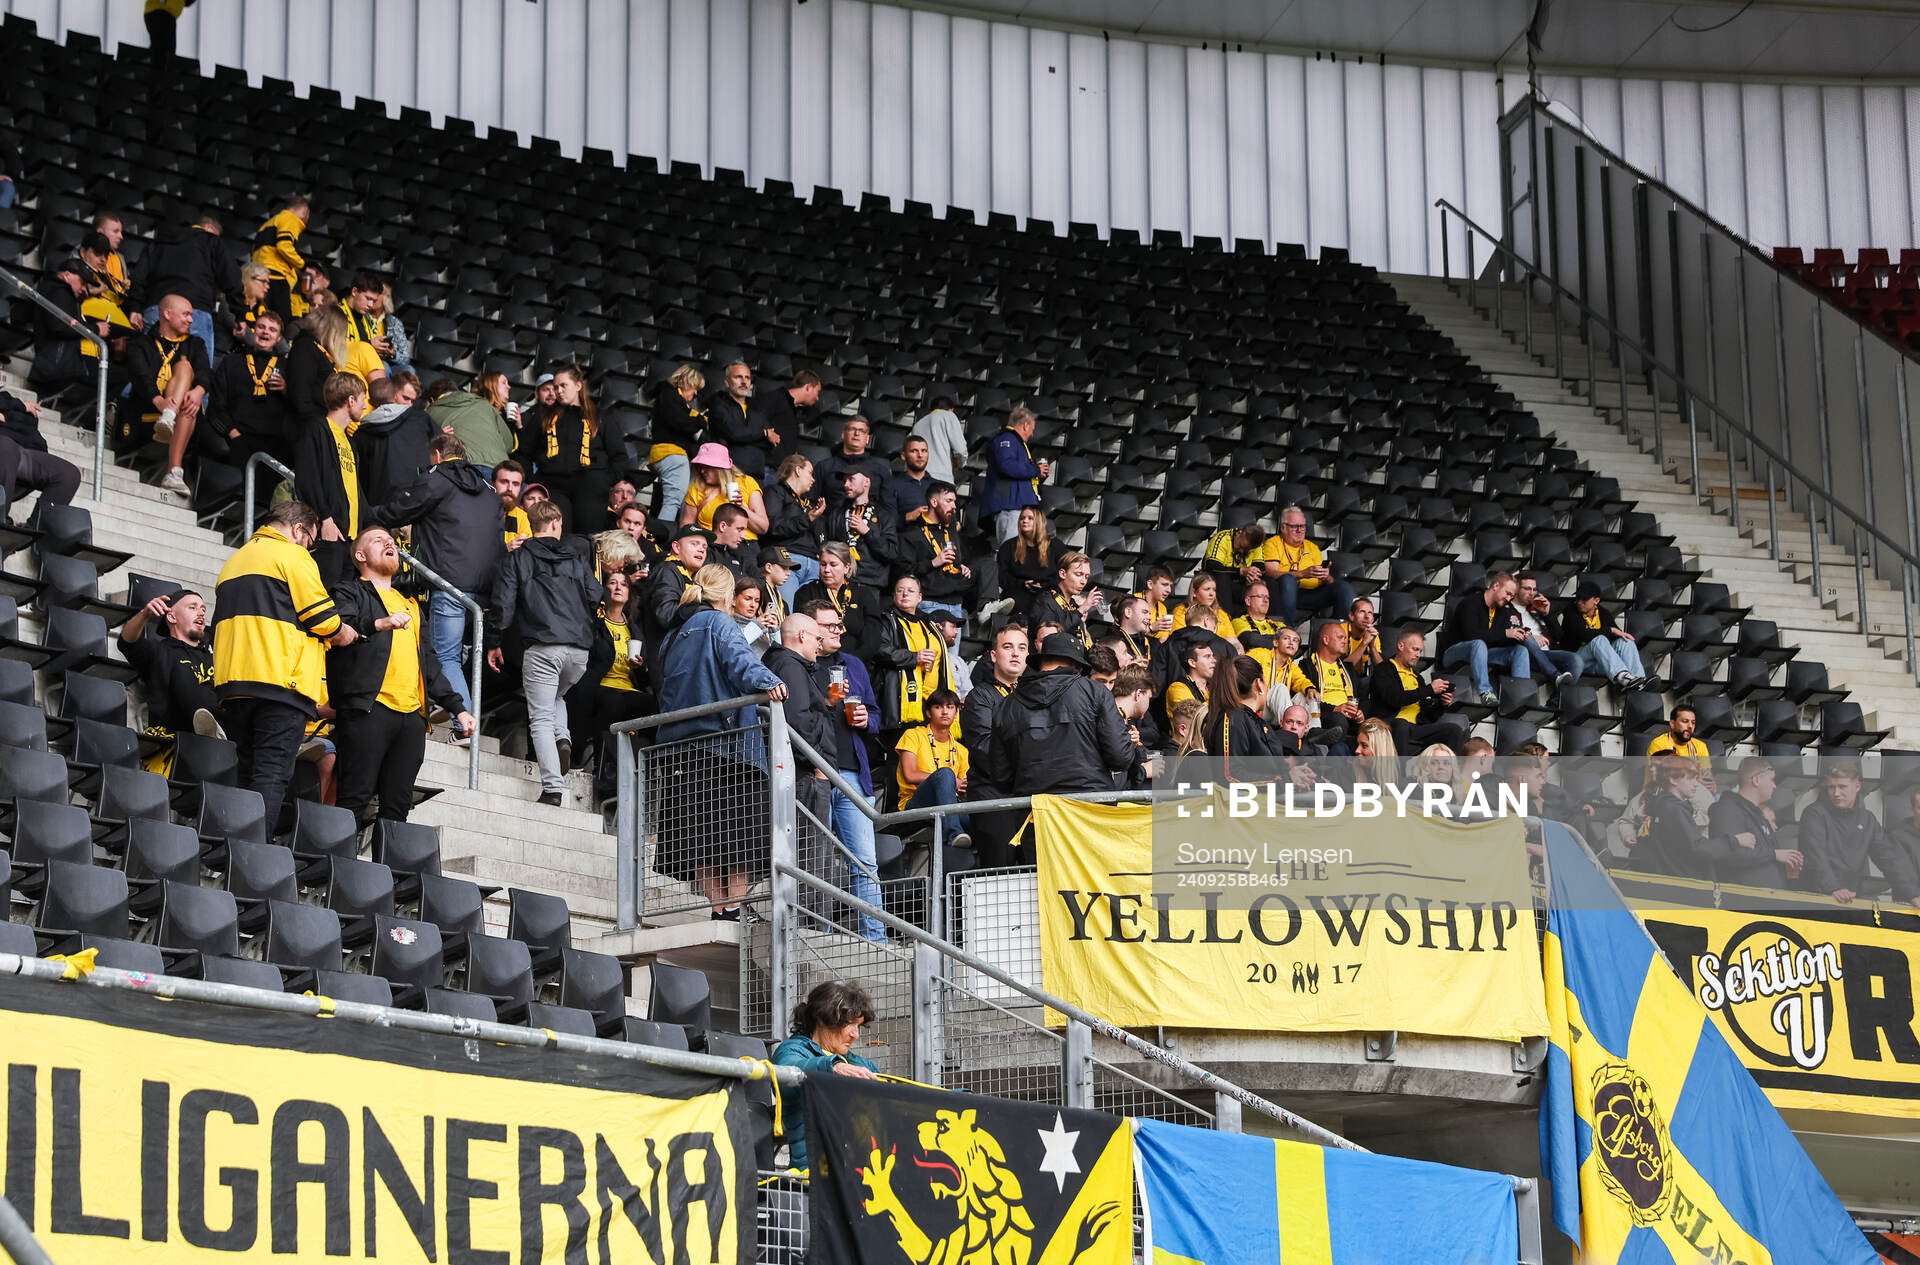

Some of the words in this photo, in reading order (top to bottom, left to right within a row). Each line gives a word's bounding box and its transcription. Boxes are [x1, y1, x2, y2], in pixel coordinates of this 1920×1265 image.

[160, 492, 168, 502] 16
[1786, 552, 1795, 560] 21
[1873, 624, 1881, 633] 19
[523, 764, 533, 776] 12
[1268, 859, 1330, 881] THE
[1057, 889, 1518, 953] YELLOWSHIP
[1246, 963, 1278, 985] 20
[1332, 963, 1363, 985] 17
[1698, 938, 1842, 1010] Sektion
[1771, 992, 1829, 1070] U
[1596, 1095, 1663, 1181] Elfsborg
